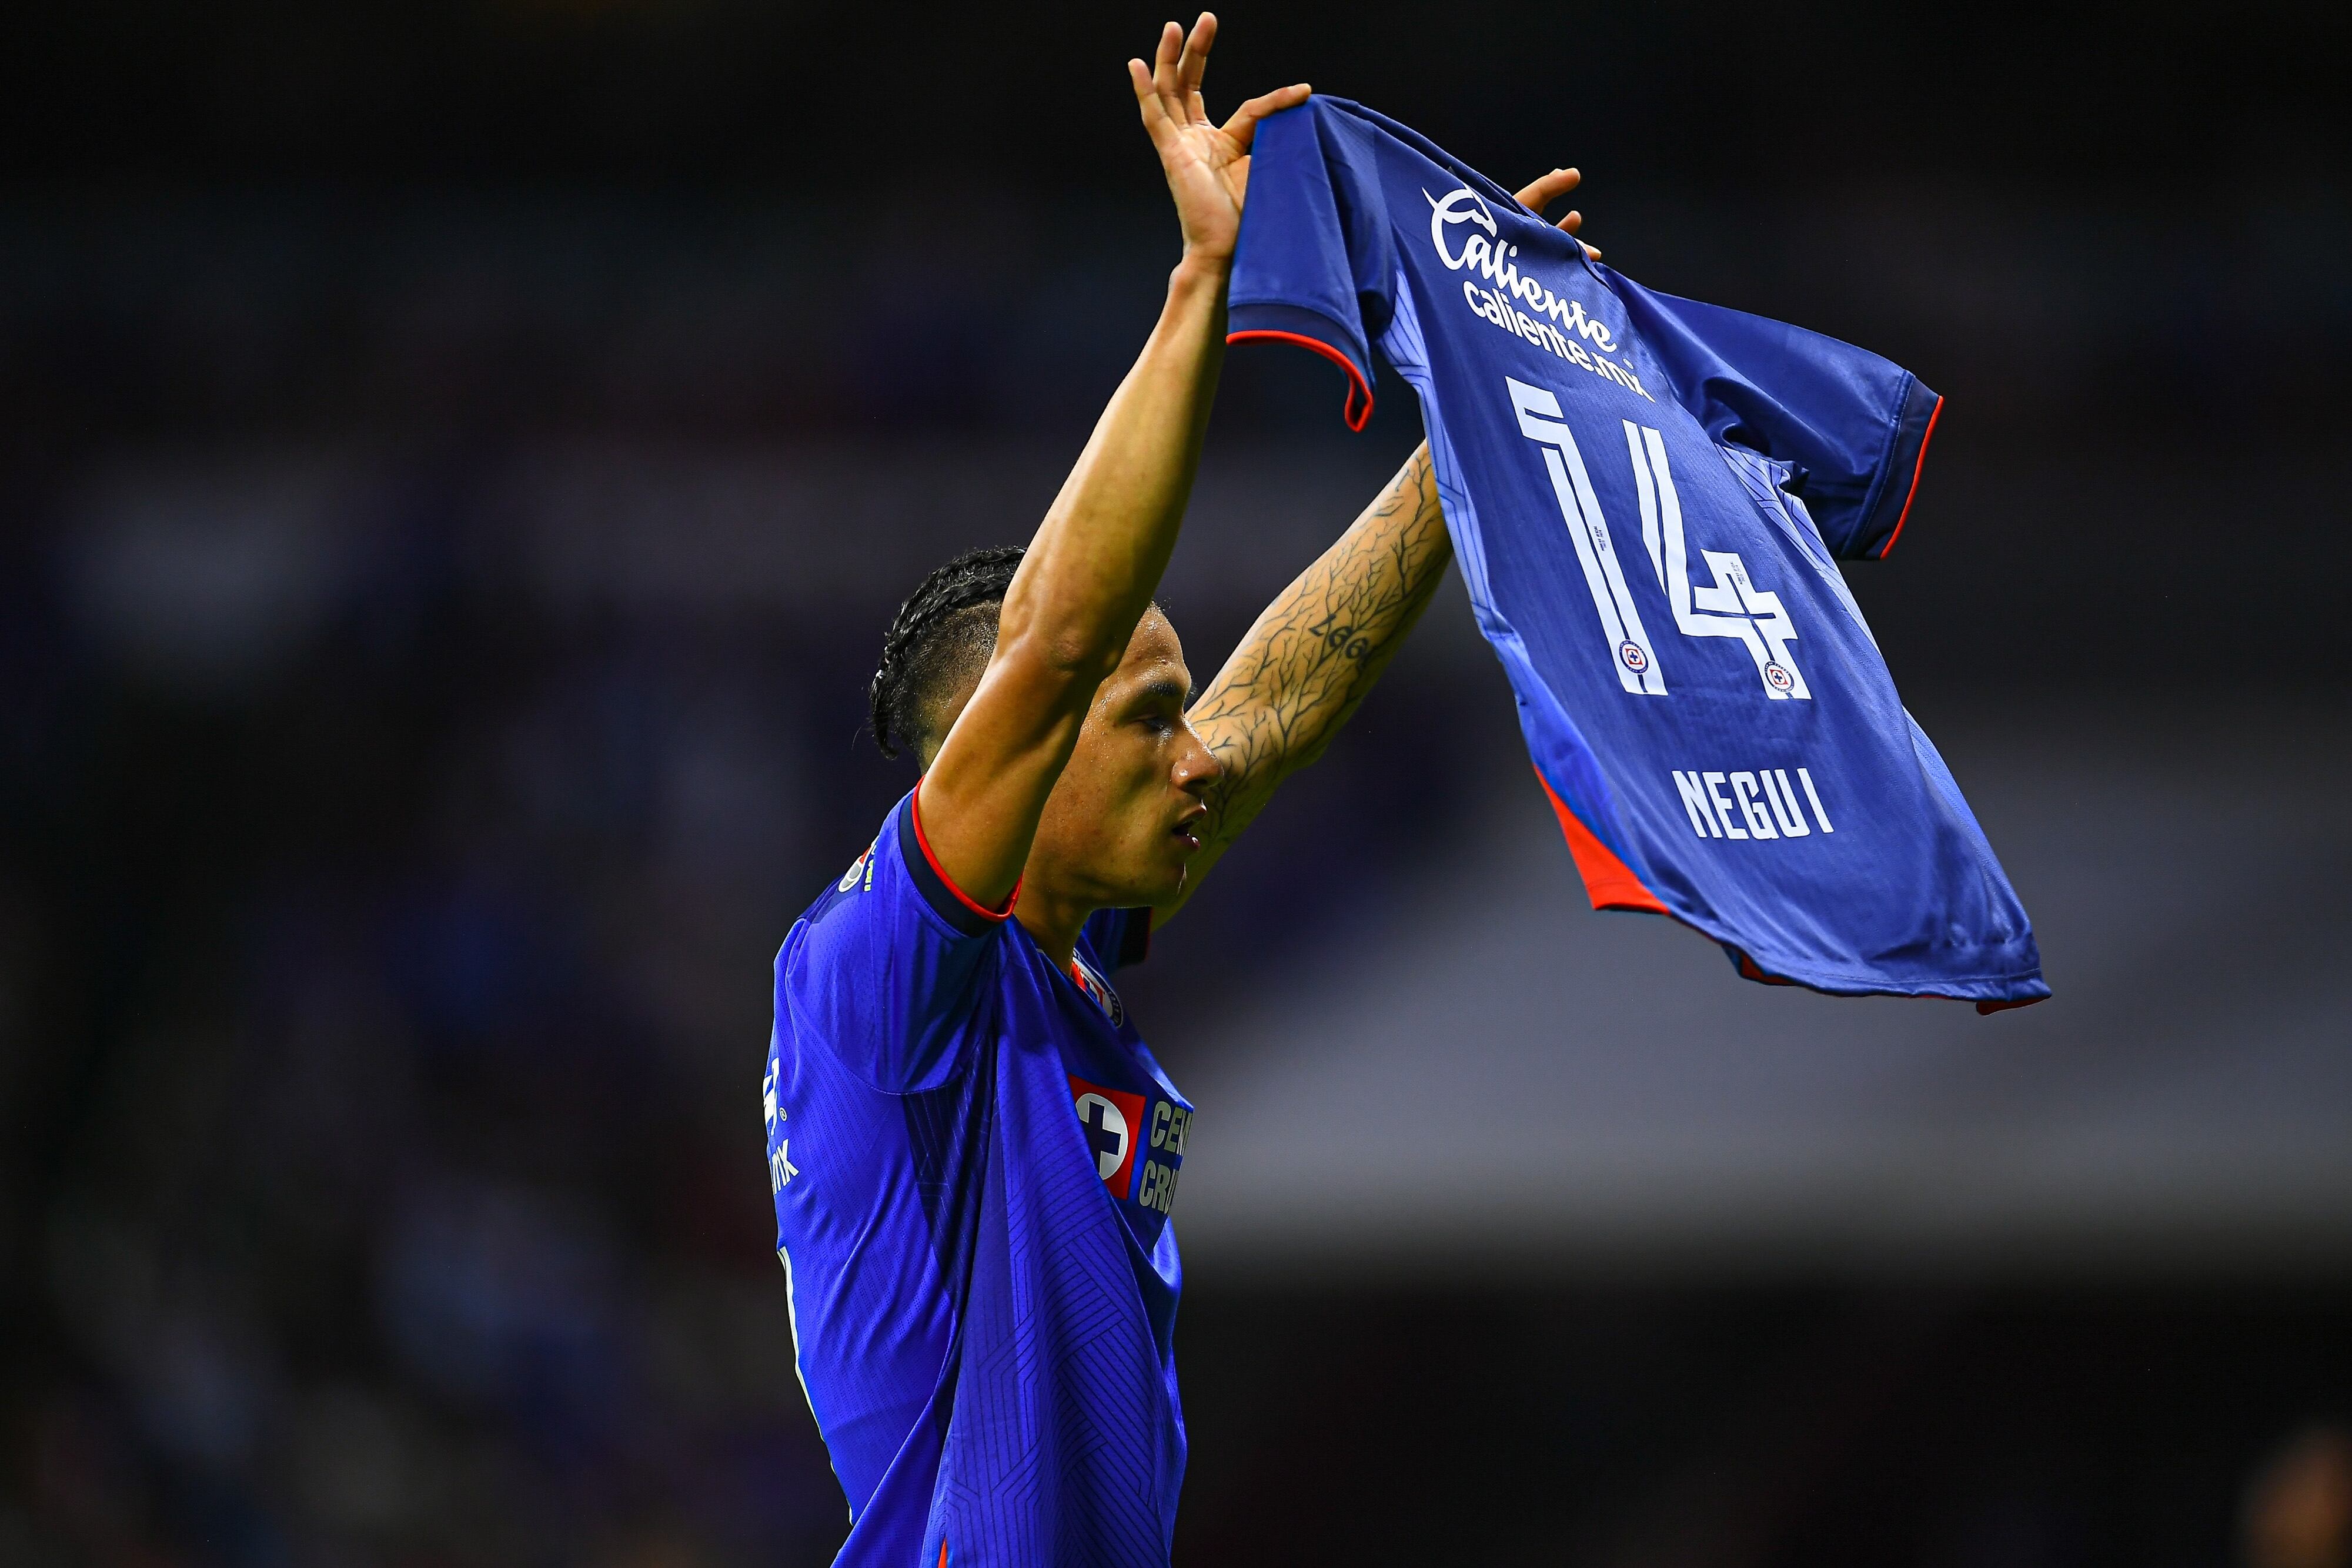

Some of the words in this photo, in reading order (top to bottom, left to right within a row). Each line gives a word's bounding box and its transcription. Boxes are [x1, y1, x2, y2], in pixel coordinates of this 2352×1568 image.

[1422, 185, 1617, 353] Caliente
[1463, 280, 1655, 403] caliente.mx
[1505, 376, 1812, 700] 14
[1672, 768, 1834, 840] NEGUI
